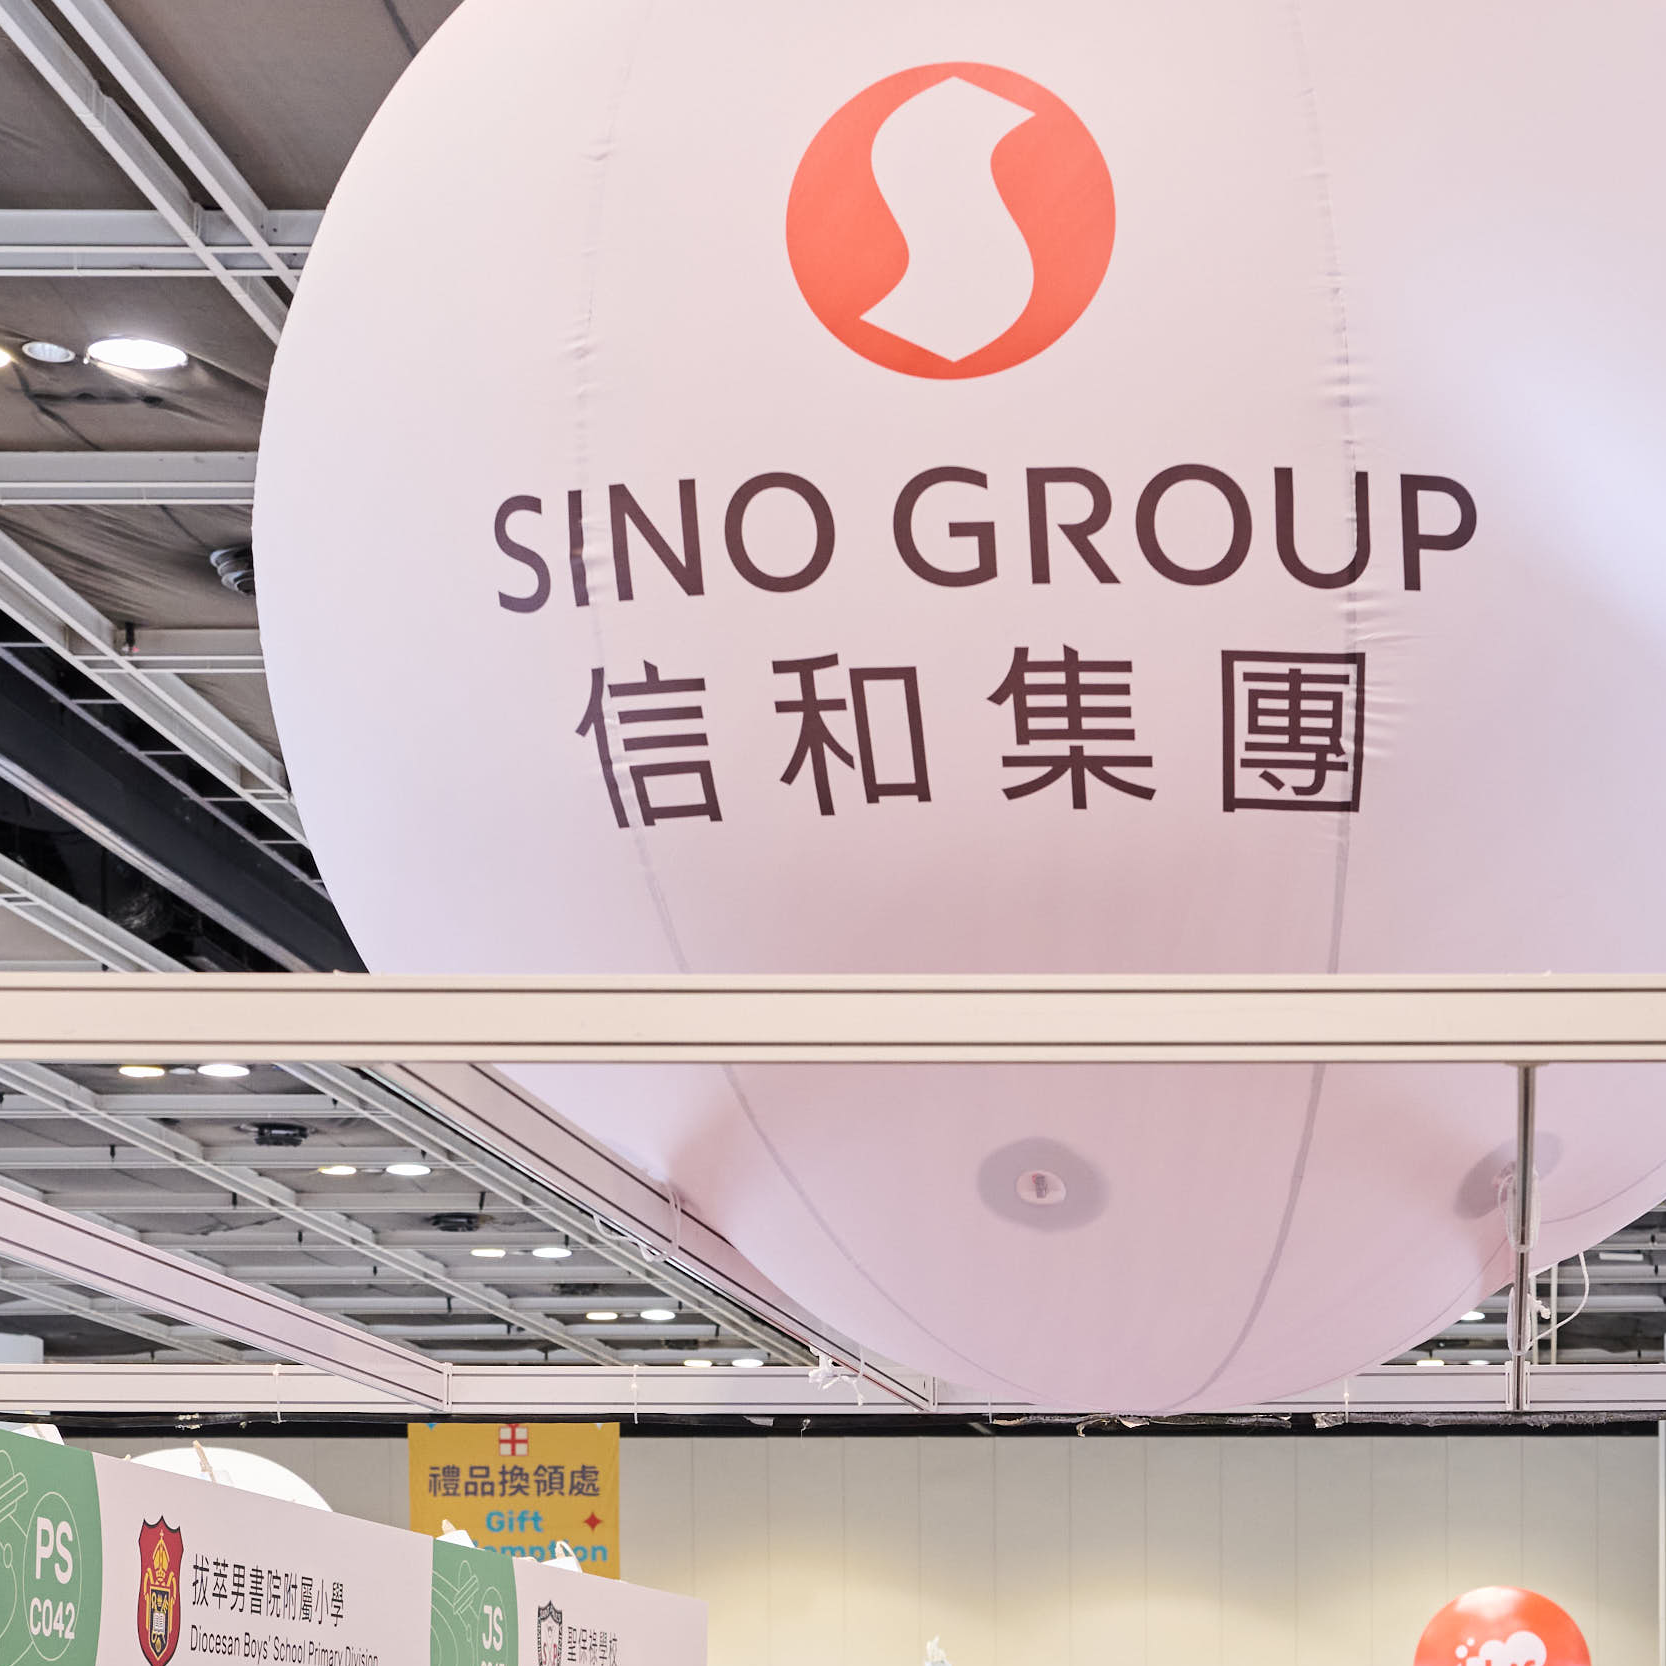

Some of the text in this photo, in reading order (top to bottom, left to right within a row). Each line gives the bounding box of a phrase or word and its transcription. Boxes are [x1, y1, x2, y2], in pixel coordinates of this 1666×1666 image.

[495, 464, 1478, 614] SINO GROUP
[577, 644, 1367, 828] 信和集團
[428, 1464, 601, 1498] 禮品換領處
[486, 1510, 544, 1533] Gift
[35, 1517, 73, 1585] PS
[192, 1553, 344, 1627] 拔萃男書院附屬小學
[29, 1598, 76, 1640] C042
[482, 1605, 504, 1652] JS
[190, 1624, 241, 1659] Diocesan
[243, 1631, 271, 1664] Boys'
[273, 1634, 306, 1666] School
